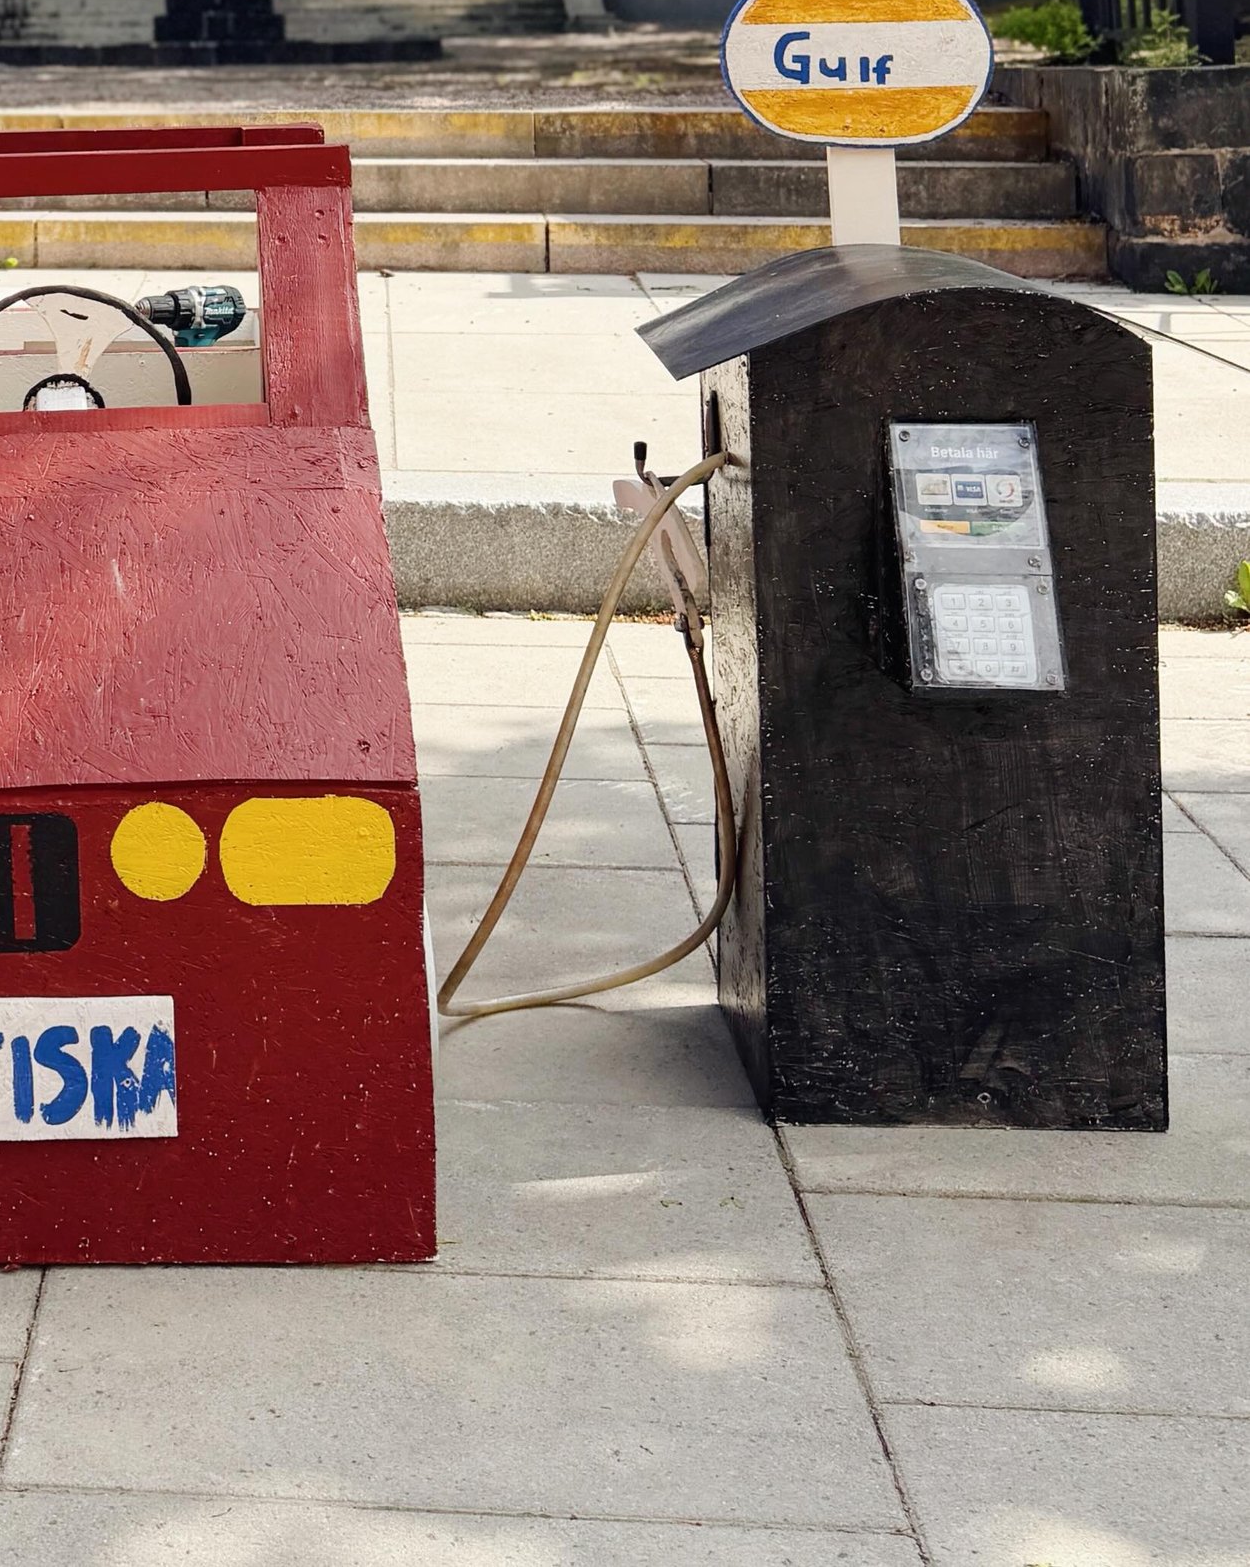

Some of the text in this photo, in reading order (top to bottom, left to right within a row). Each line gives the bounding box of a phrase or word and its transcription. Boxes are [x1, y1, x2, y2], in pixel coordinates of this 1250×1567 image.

[773, 31, 894, 85] Gulf
[930, 446, 999, 459] Betala här
